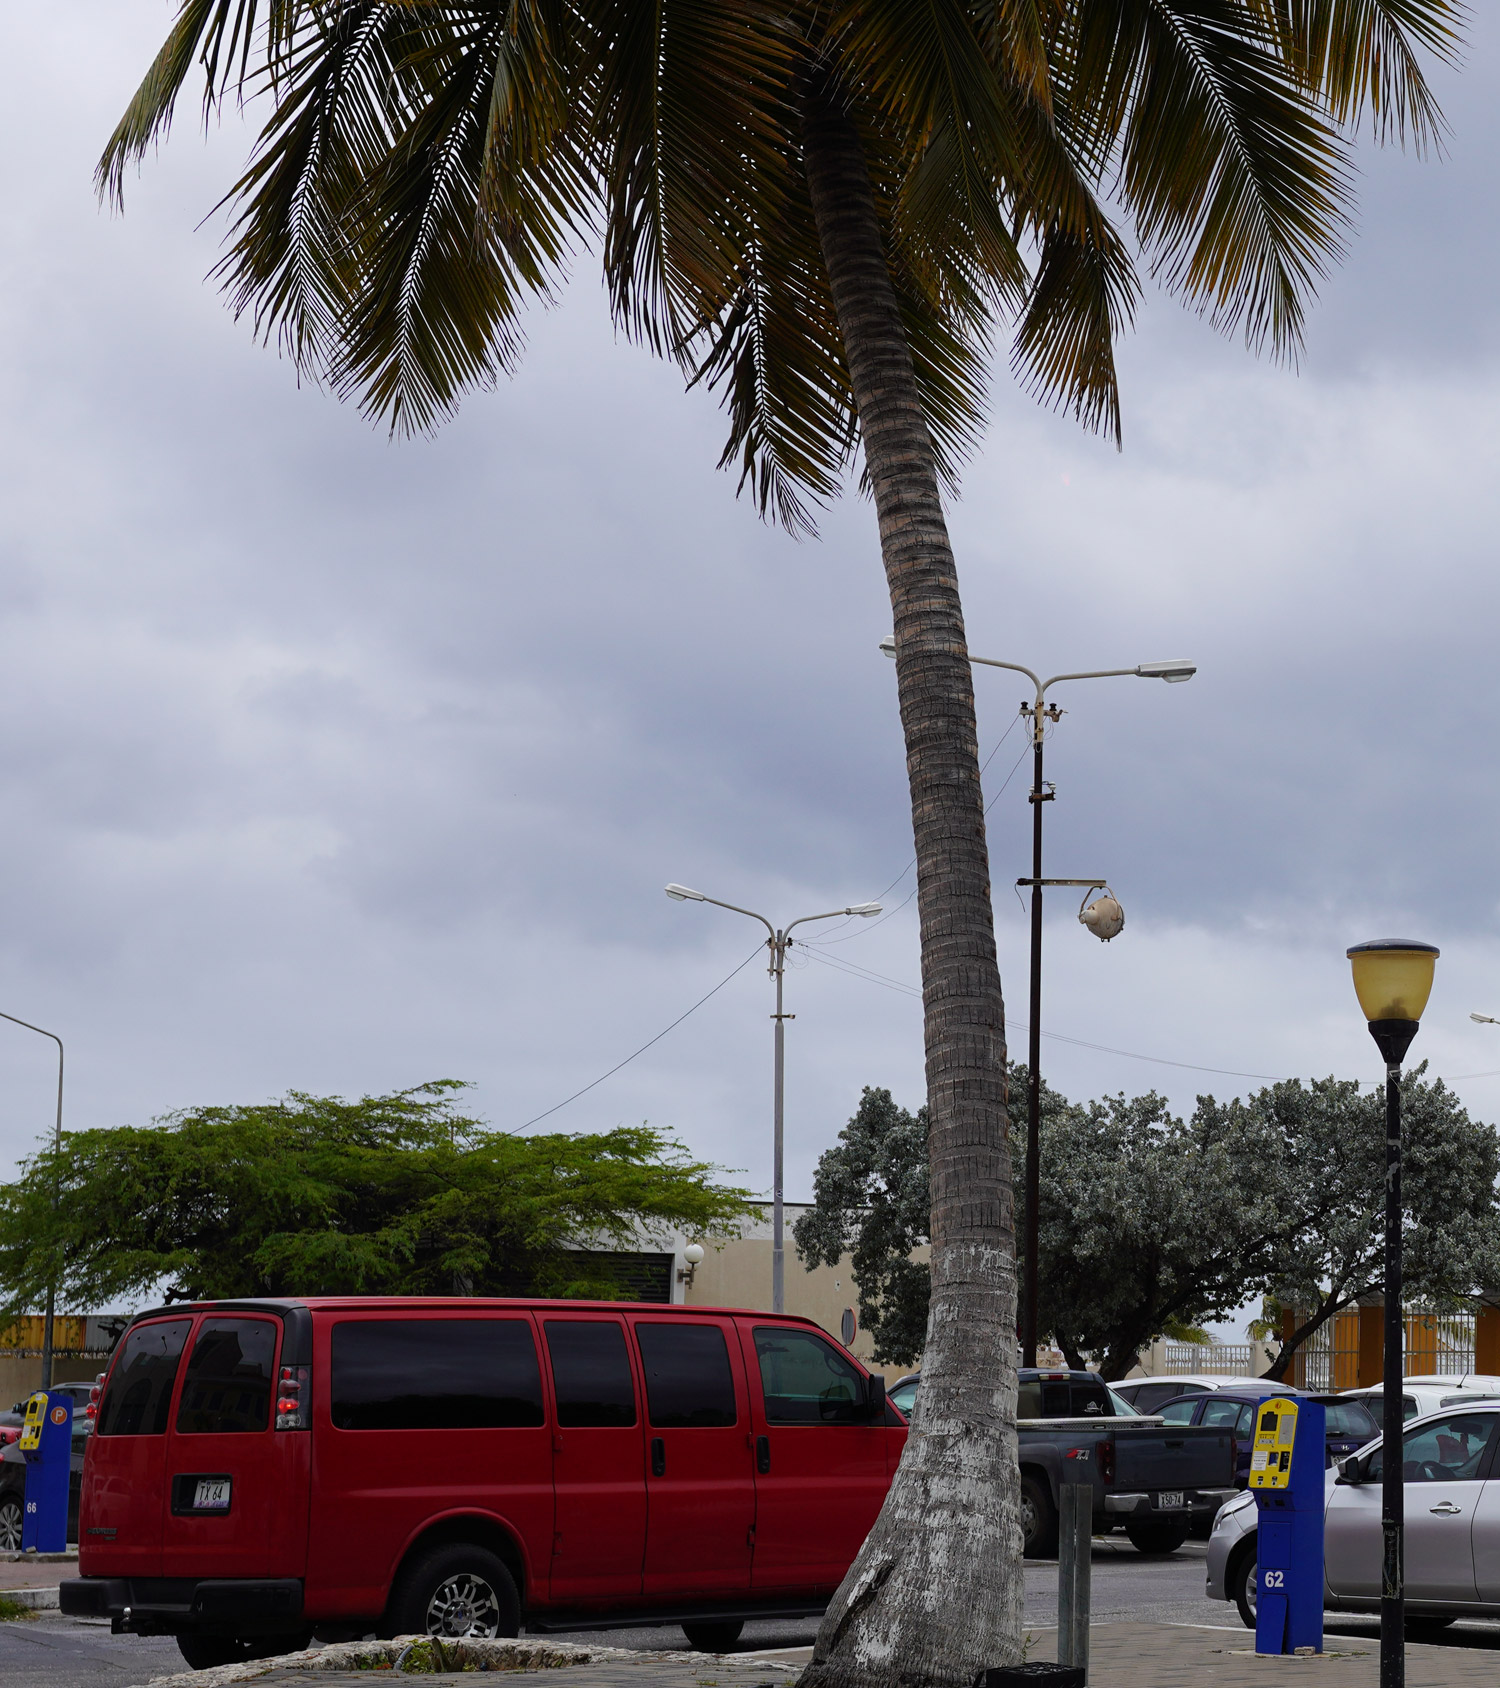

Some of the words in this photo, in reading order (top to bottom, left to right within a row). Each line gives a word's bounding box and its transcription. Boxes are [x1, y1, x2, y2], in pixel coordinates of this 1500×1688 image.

[55, 1409, 64, 1421] P
[200, 1486, 211, 1500] TX
[212, 1486, 224, 1500] 64
[27, 1502, 37, 1513] 66
[1264, 1571, 1284, 1588] 62
